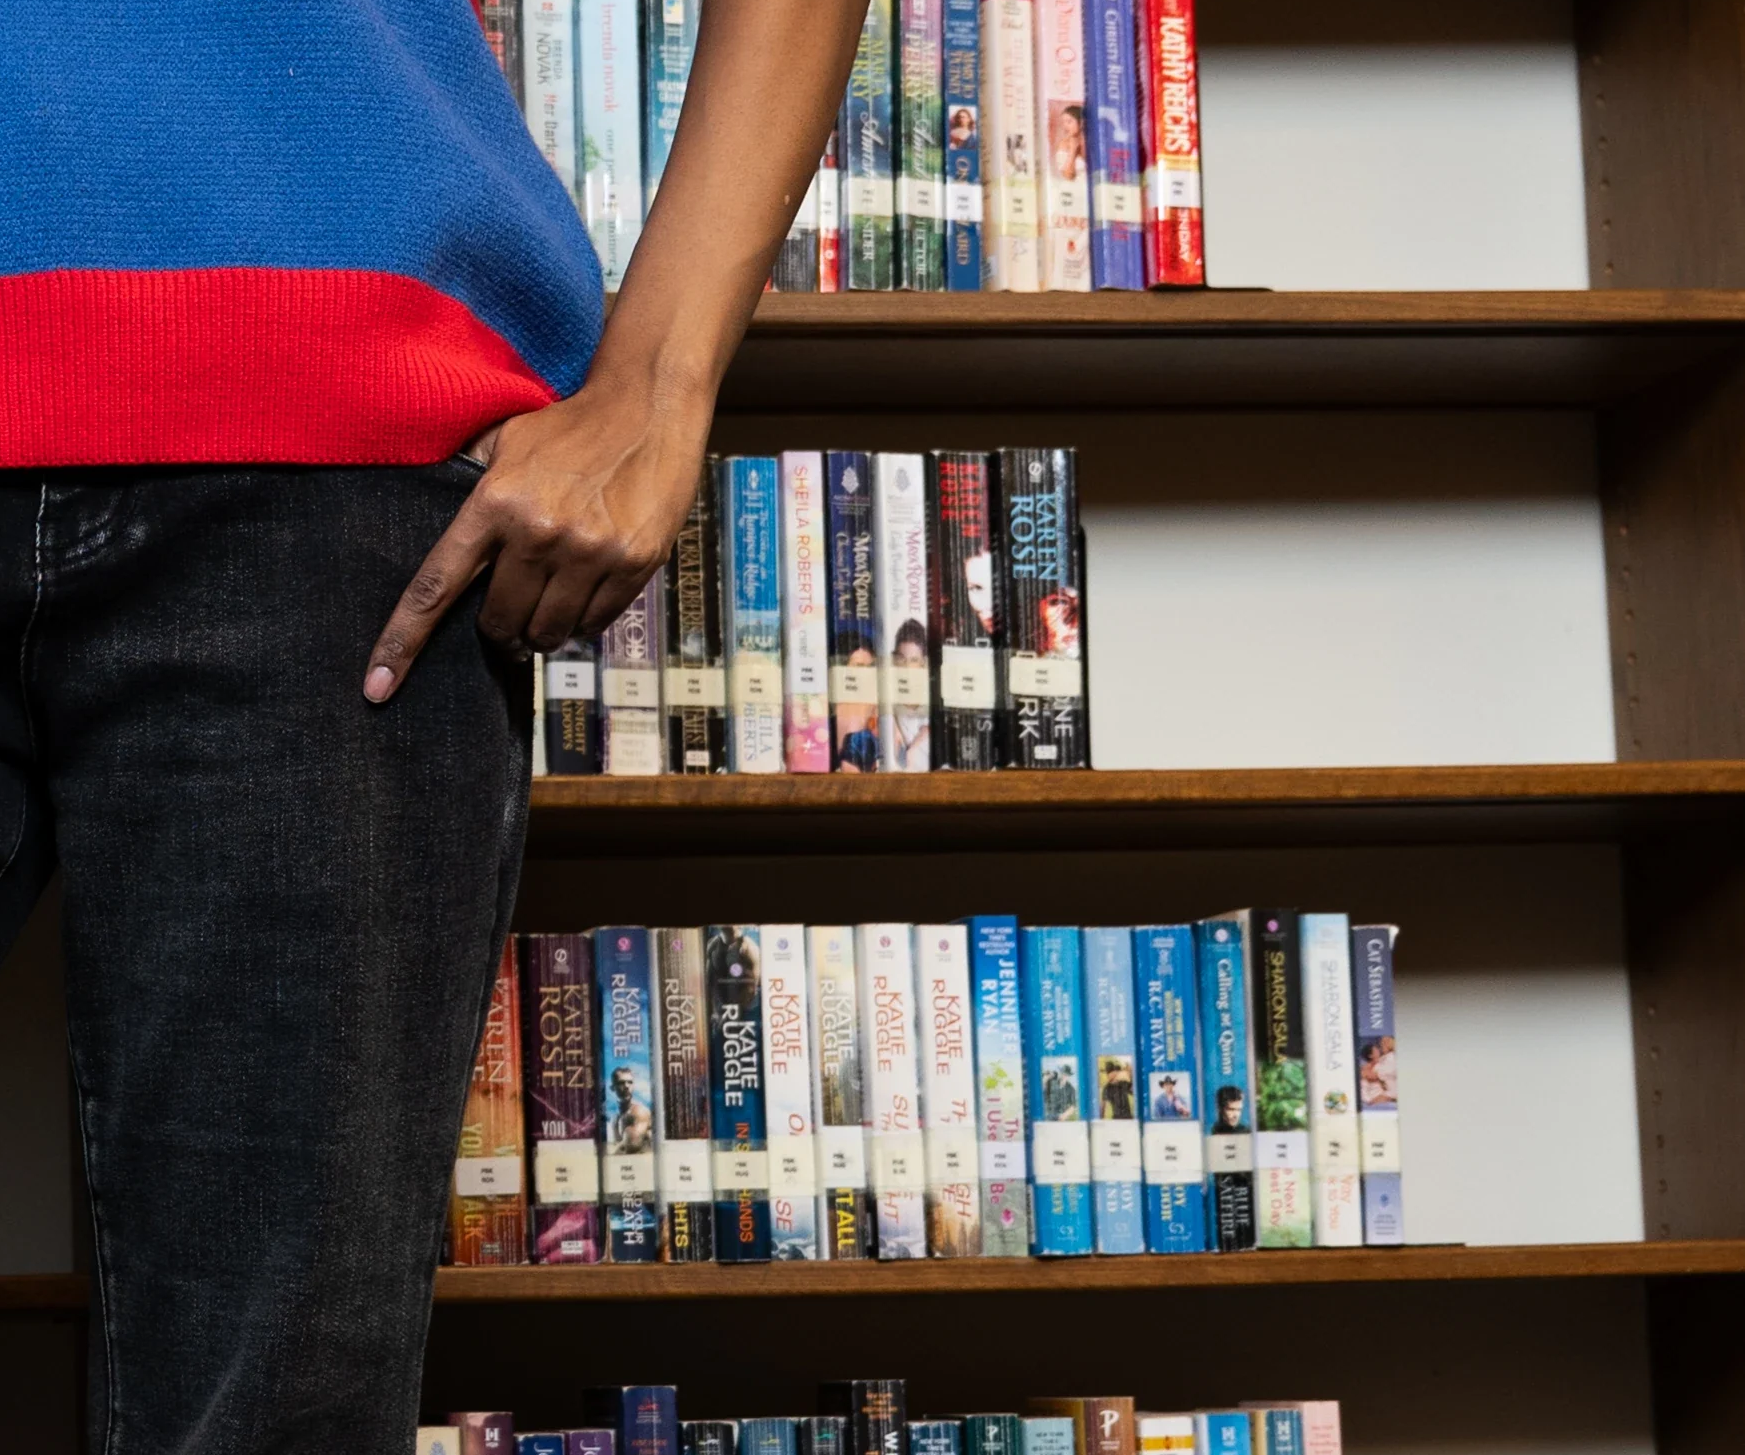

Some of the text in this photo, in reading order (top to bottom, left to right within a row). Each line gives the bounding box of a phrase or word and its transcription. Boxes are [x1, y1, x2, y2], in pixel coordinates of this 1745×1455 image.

[535, 32, 558, 87] NOVAK
[553, 38, 565, 82] BRENDA
[600, 3, 620, 114] brenda novak
[1159, 17, 1192, 152] KATHY REICHS
[795, 465, 814, 615] SHEILA ROBERTS
[1009, 494, 1036, 580] ROSE
[1035, 492, 1059, 580] KAREN
[539, 985, 567, 1088] ROSE
[564, 984, 587, 1089] KAREN
[719, 1003, 743, 1108] RUGGLE
[737, 1020, 758, 1090] KATIE
[1267, 950, 1289, 1064] SHARON SALA
